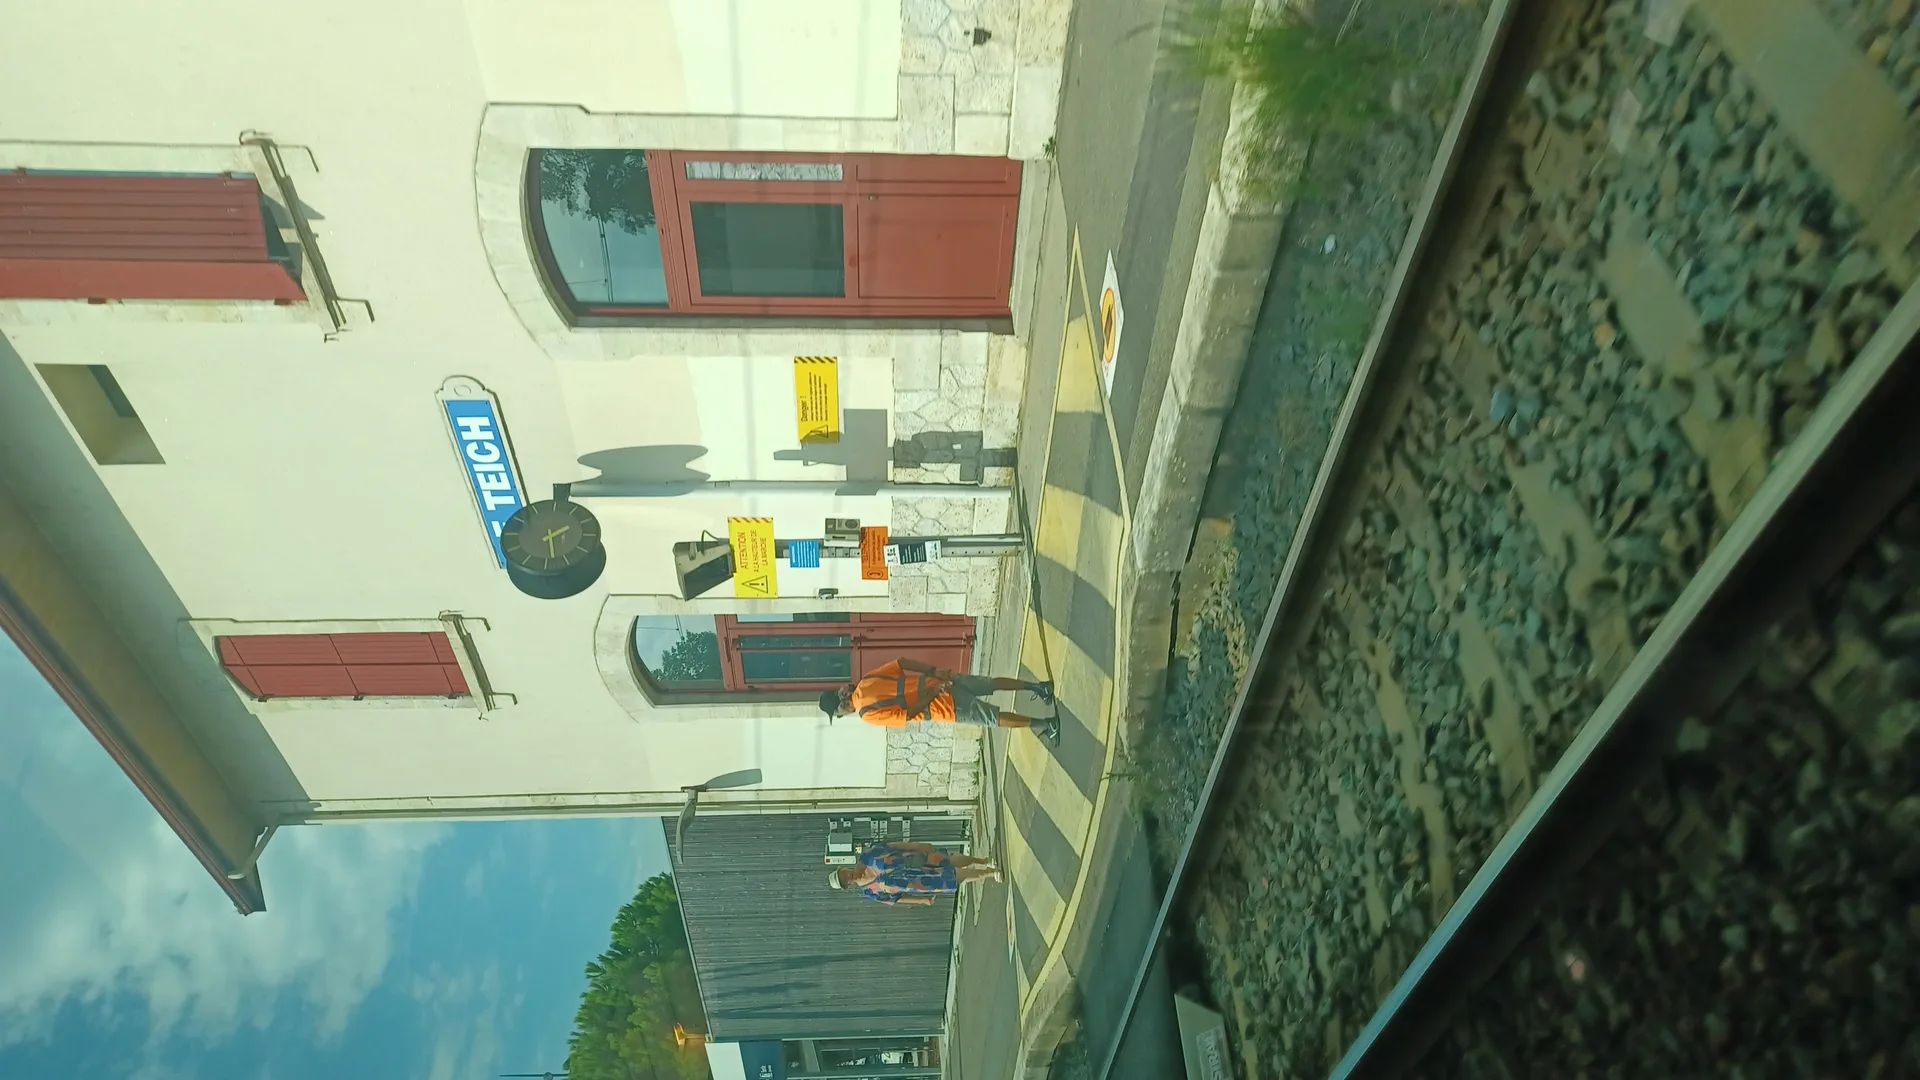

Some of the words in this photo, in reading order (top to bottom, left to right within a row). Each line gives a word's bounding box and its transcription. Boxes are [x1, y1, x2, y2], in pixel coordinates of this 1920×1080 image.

[800, 400, 809, 422] Danger
[457, 417, 515, 511] TEICH
[750, 529, 757, 537] DE
[737, 532, 748, 569] ATTENTION
